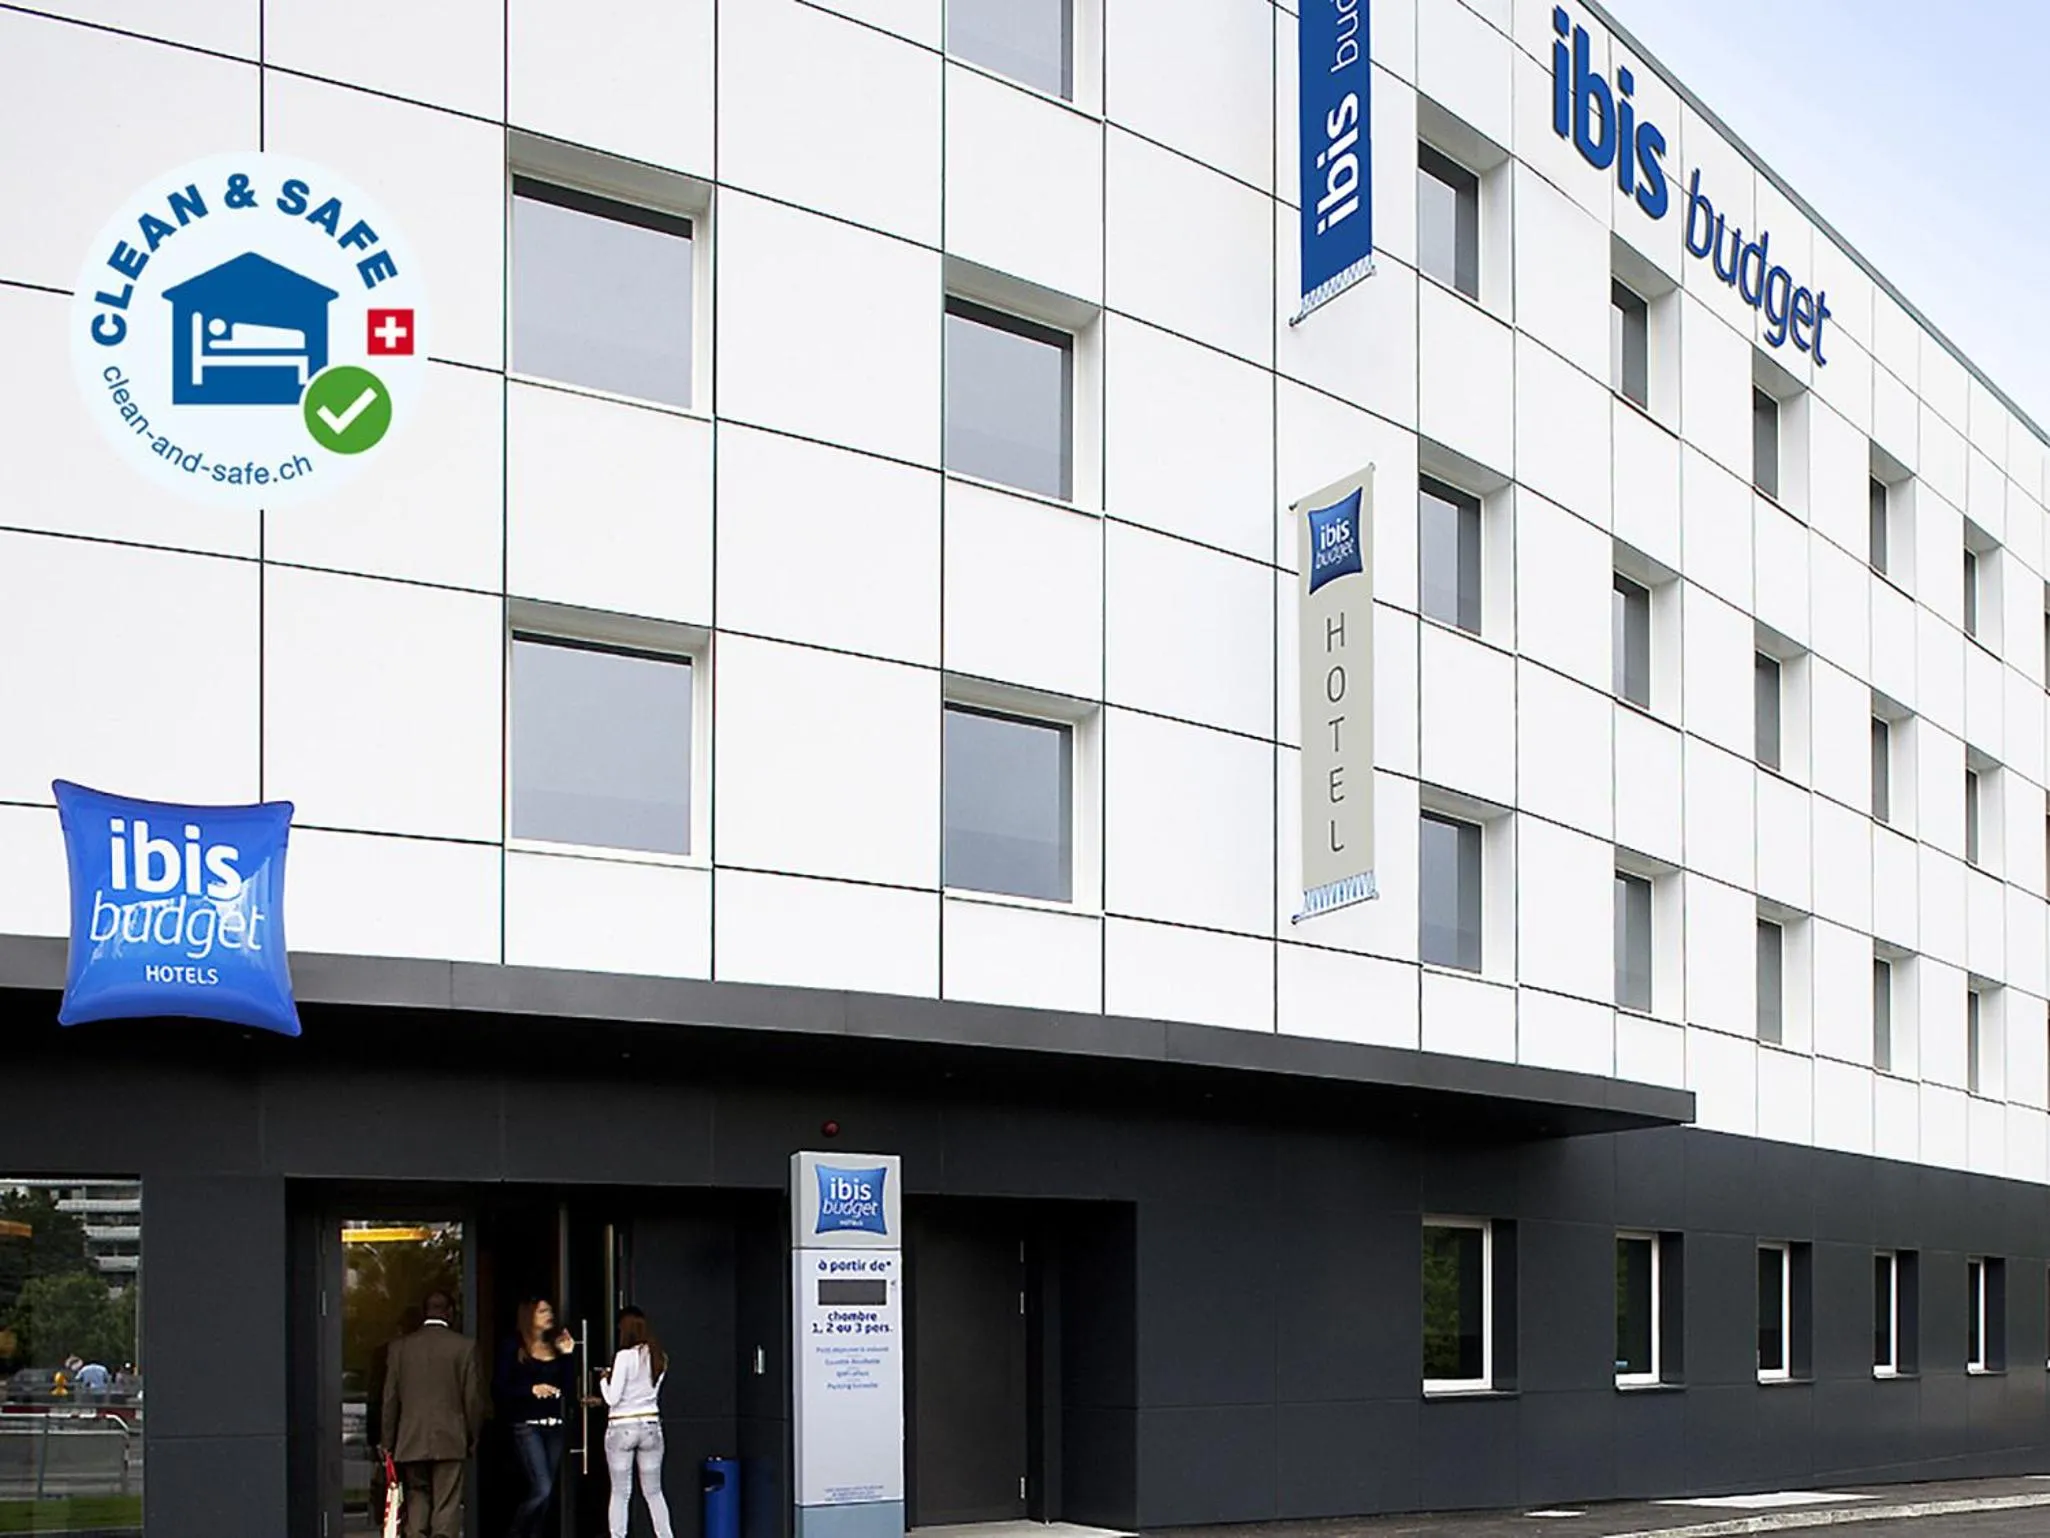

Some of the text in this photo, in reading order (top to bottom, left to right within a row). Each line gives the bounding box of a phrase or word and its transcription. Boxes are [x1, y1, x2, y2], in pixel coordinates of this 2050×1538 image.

[1317, 92, 1359, 236] ibis
[1552, 5, 1832, 367] ibis budget
[1320, 517, 1350, 550] ibis
[1326, 611, 1346, 852] HOTEL
[110, 818, 242, 900] ibis
[90, 889, 265, 959] budget
[145, 964, 220, 985] HOTELS
[830, 1177, 872, 1201] ibis
[822, 1199, 879, 1219] budget
[829, 1260, 867, 1274] partir
[825, 1322, 834, 1334] 2
[854, 1322, 863, 1334] 3
[827, 1310, 878, 1322] chambre
